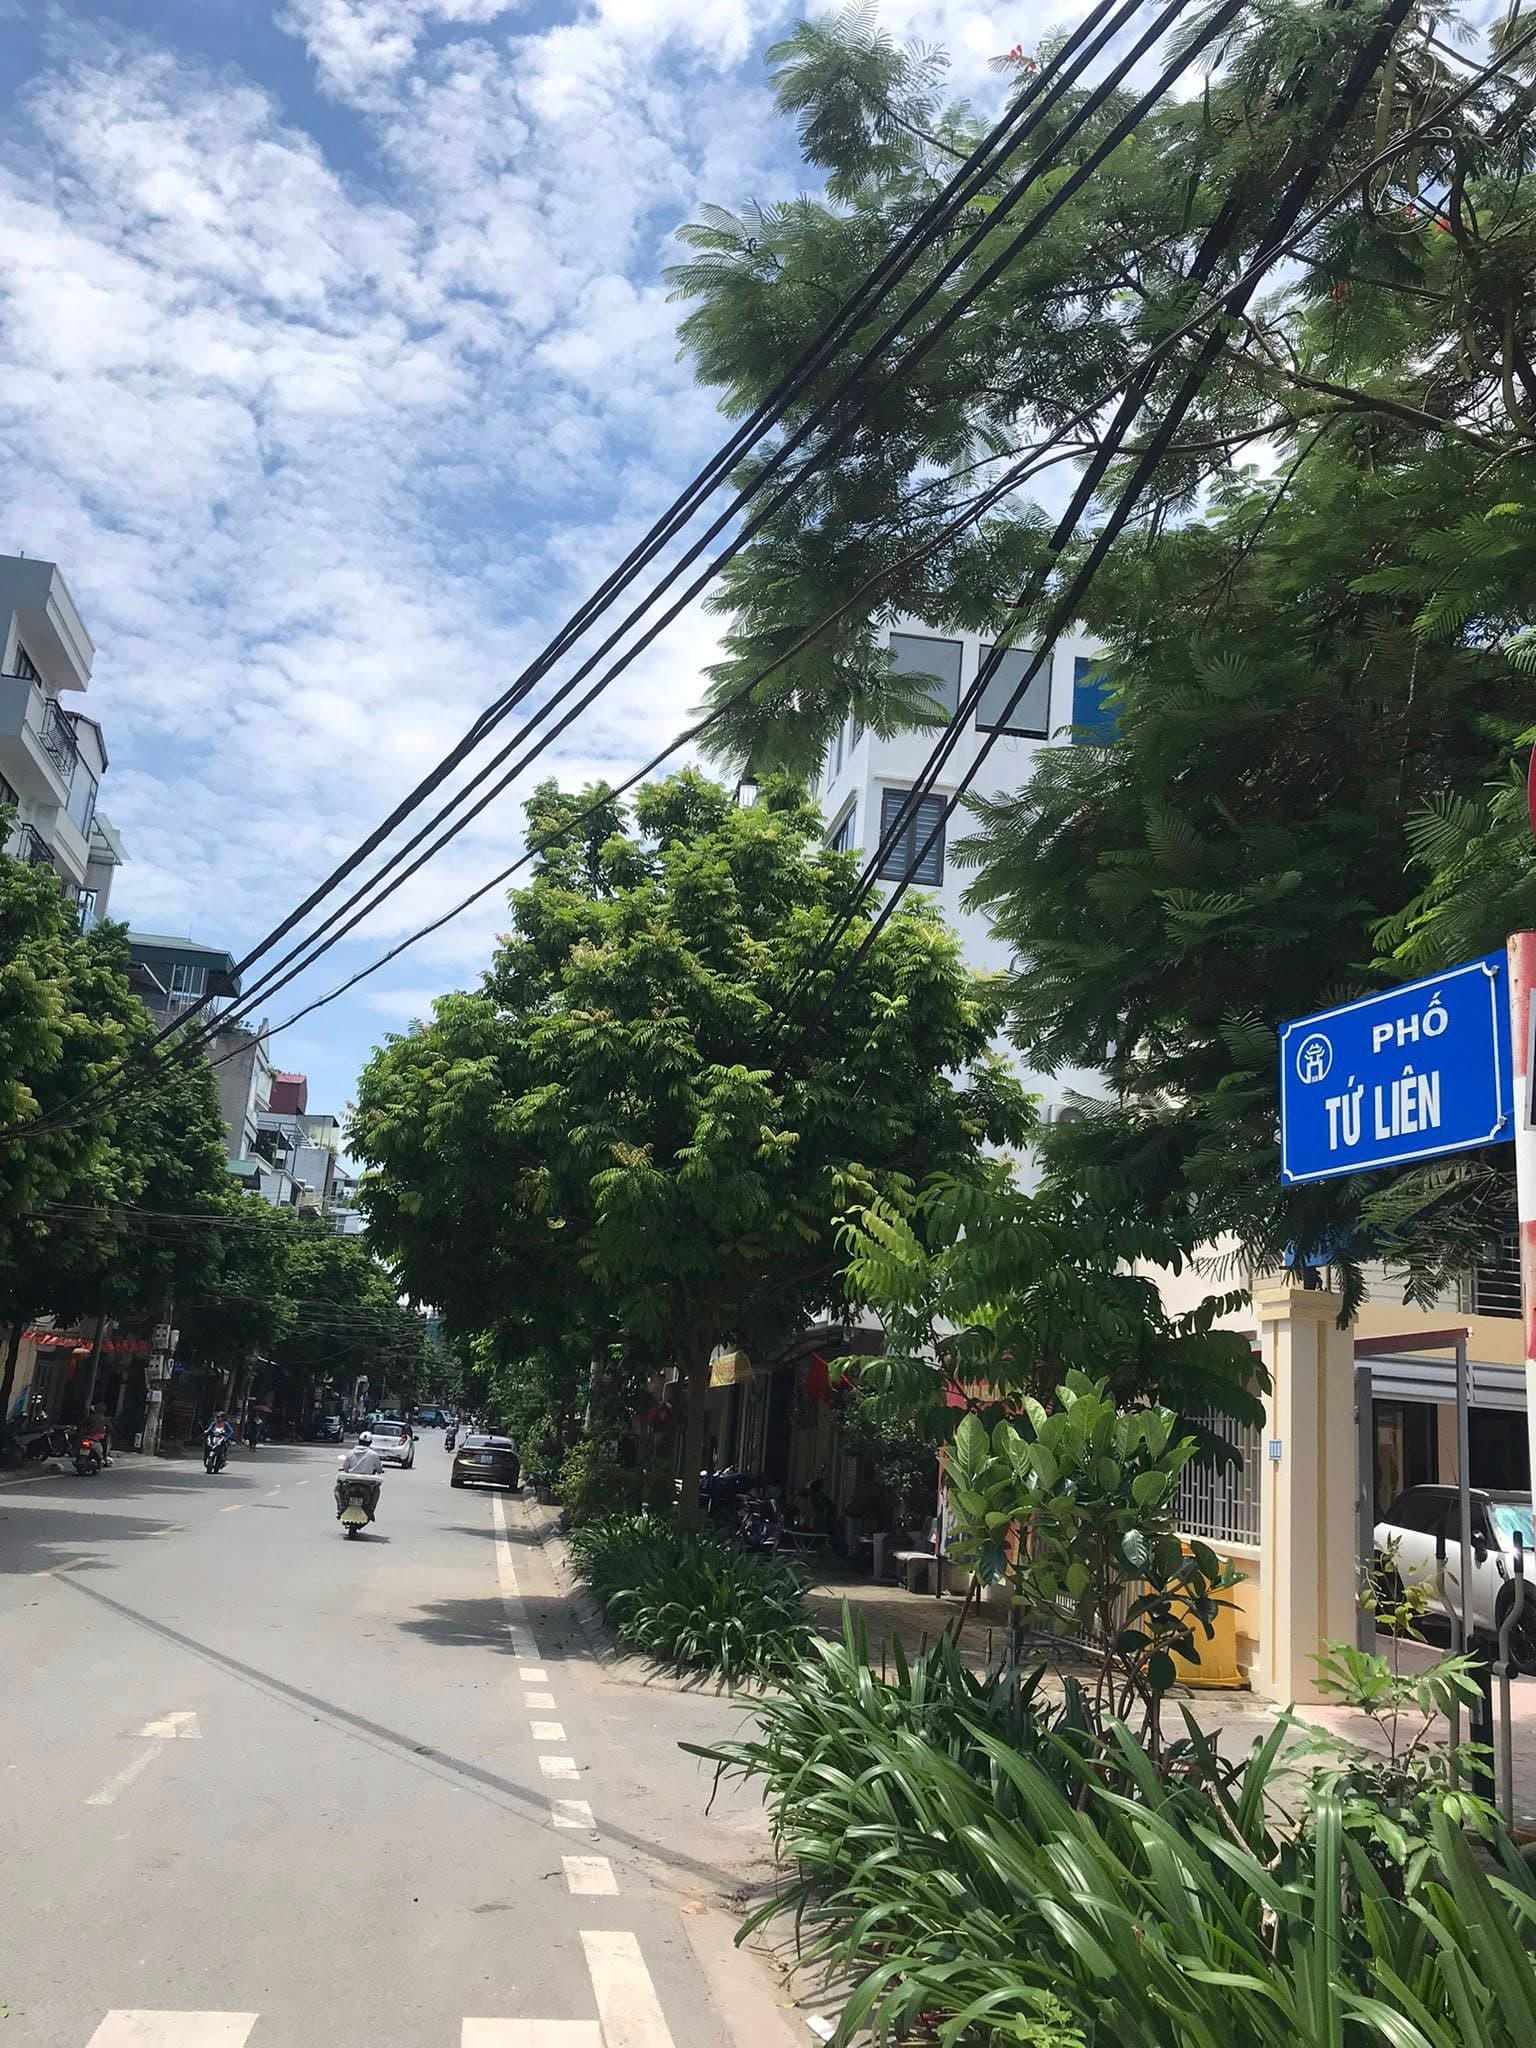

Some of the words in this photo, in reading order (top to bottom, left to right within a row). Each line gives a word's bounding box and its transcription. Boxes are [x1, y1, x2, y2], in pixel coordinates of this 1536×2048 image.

[1372, 989, 1449, 1054] PHỐ
[1325, 1074, 1365, 1151] TỨ
[1374, 1064, 1441, 1141] LIÊN
